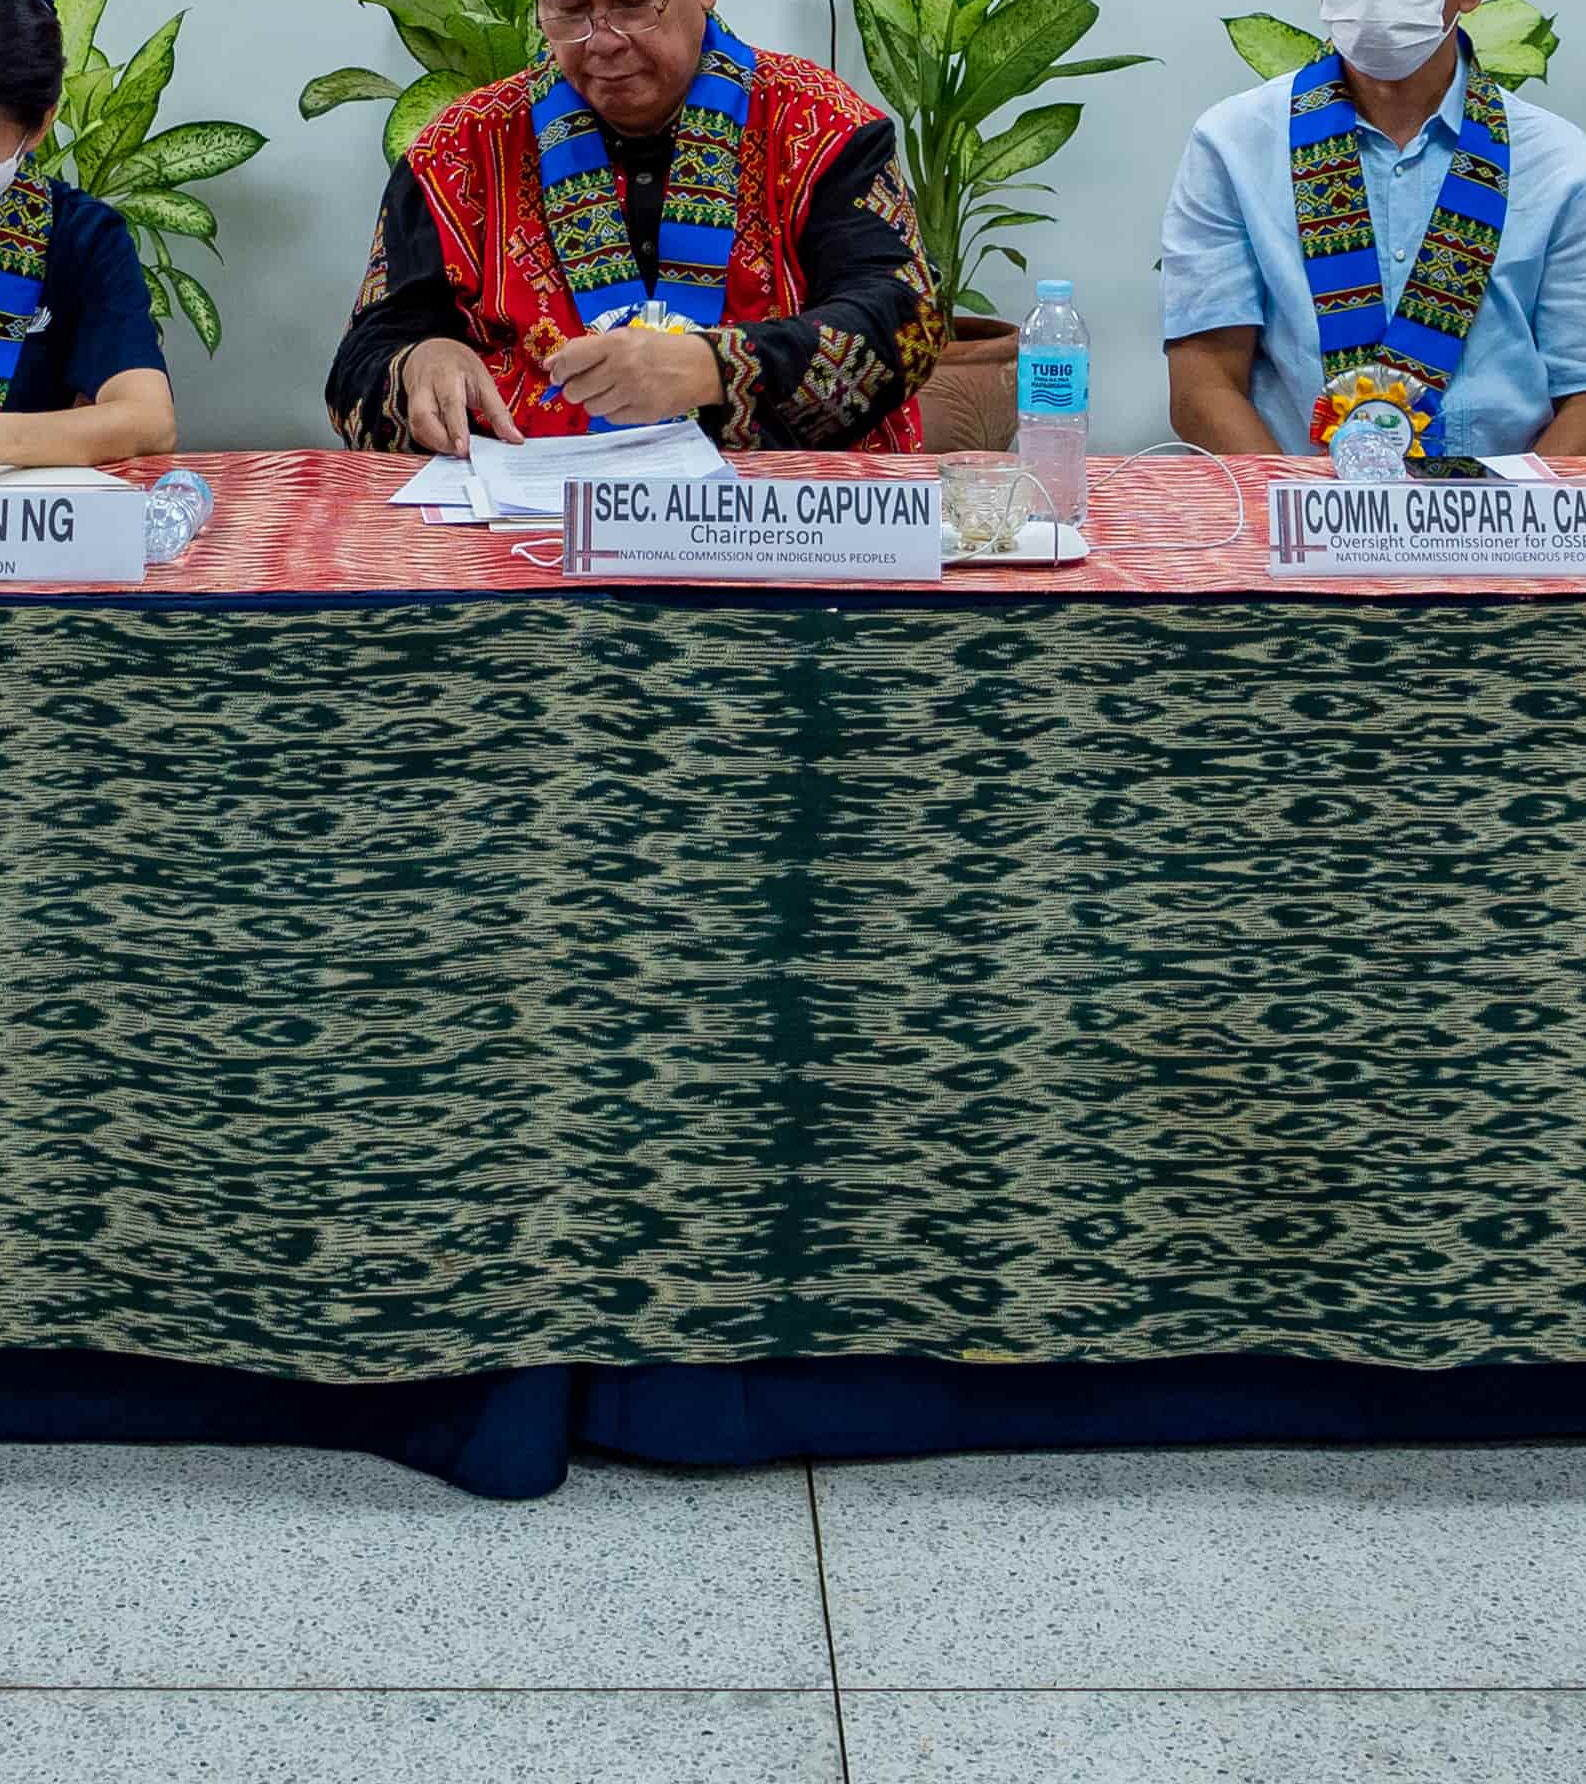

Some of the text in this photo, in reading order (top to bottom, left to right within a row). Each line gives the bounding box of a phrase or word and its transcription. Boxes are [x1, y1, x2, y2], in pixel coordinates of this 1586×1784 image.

[1031, 362, 1073, 377] TUBIG
[594, 482, 930, 526] SEC. ALLEN A. CAPUYAN
[1304, 489, 1398, 535] COMM.
[1405, 489, 1514, 535] GASPAR
[1521, 489, 1546, 534] A.
[21, 497, 75, 543] NG
[689, 524, 824, 547] Chairperson
[1329, 534, 1405, 552] Oversight
[1409, 534, 1521, 550] Commissioner
[1524, 534, 1547, 549] for
[620, 549, 897, 565] NATIONAL COMMISSION ON INDIGENOUS PEOPLES
[1335, 551, 1393, 563] NATIONAL
[1394, 551, 1468, 563] COMMISSION
[1470, 551, 1489, 563] ON
[1490, 551, 1561, 563] INDIGENOUS
